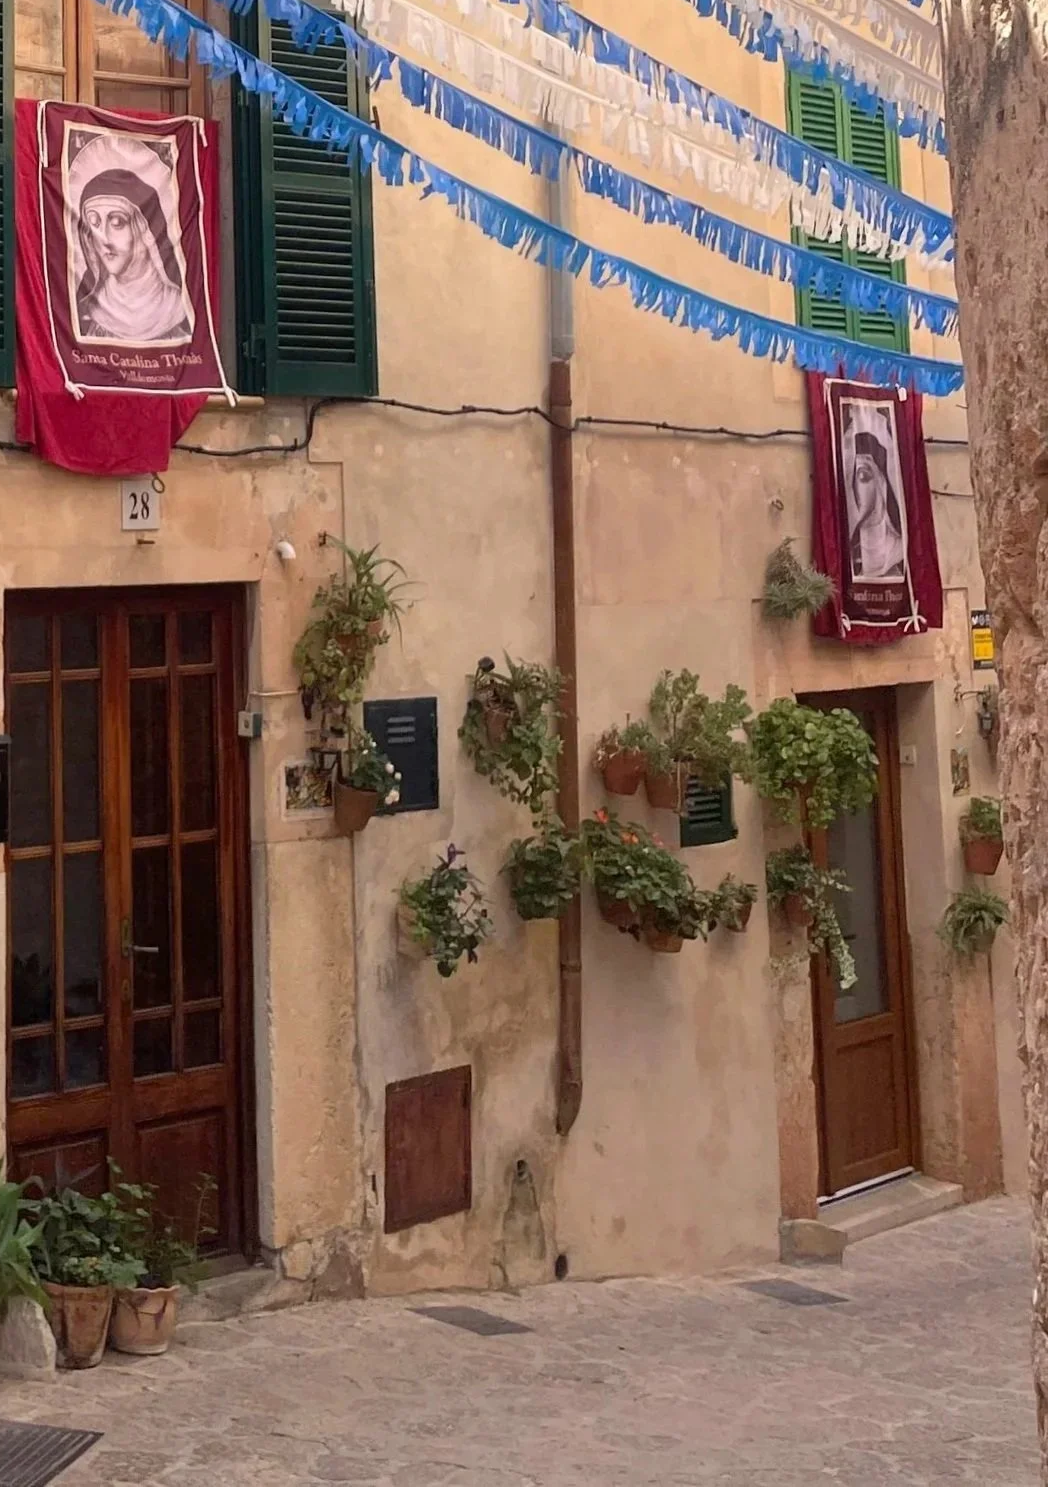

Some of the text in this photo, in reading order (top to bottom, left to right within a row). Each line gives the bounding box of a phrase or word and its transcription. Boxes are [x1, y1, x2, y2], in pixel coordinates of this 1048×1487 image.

[71, 349, 107, 364] Santa
[110, 353, 160, 369] Catalina
[129, 492, 149, 520] 28
